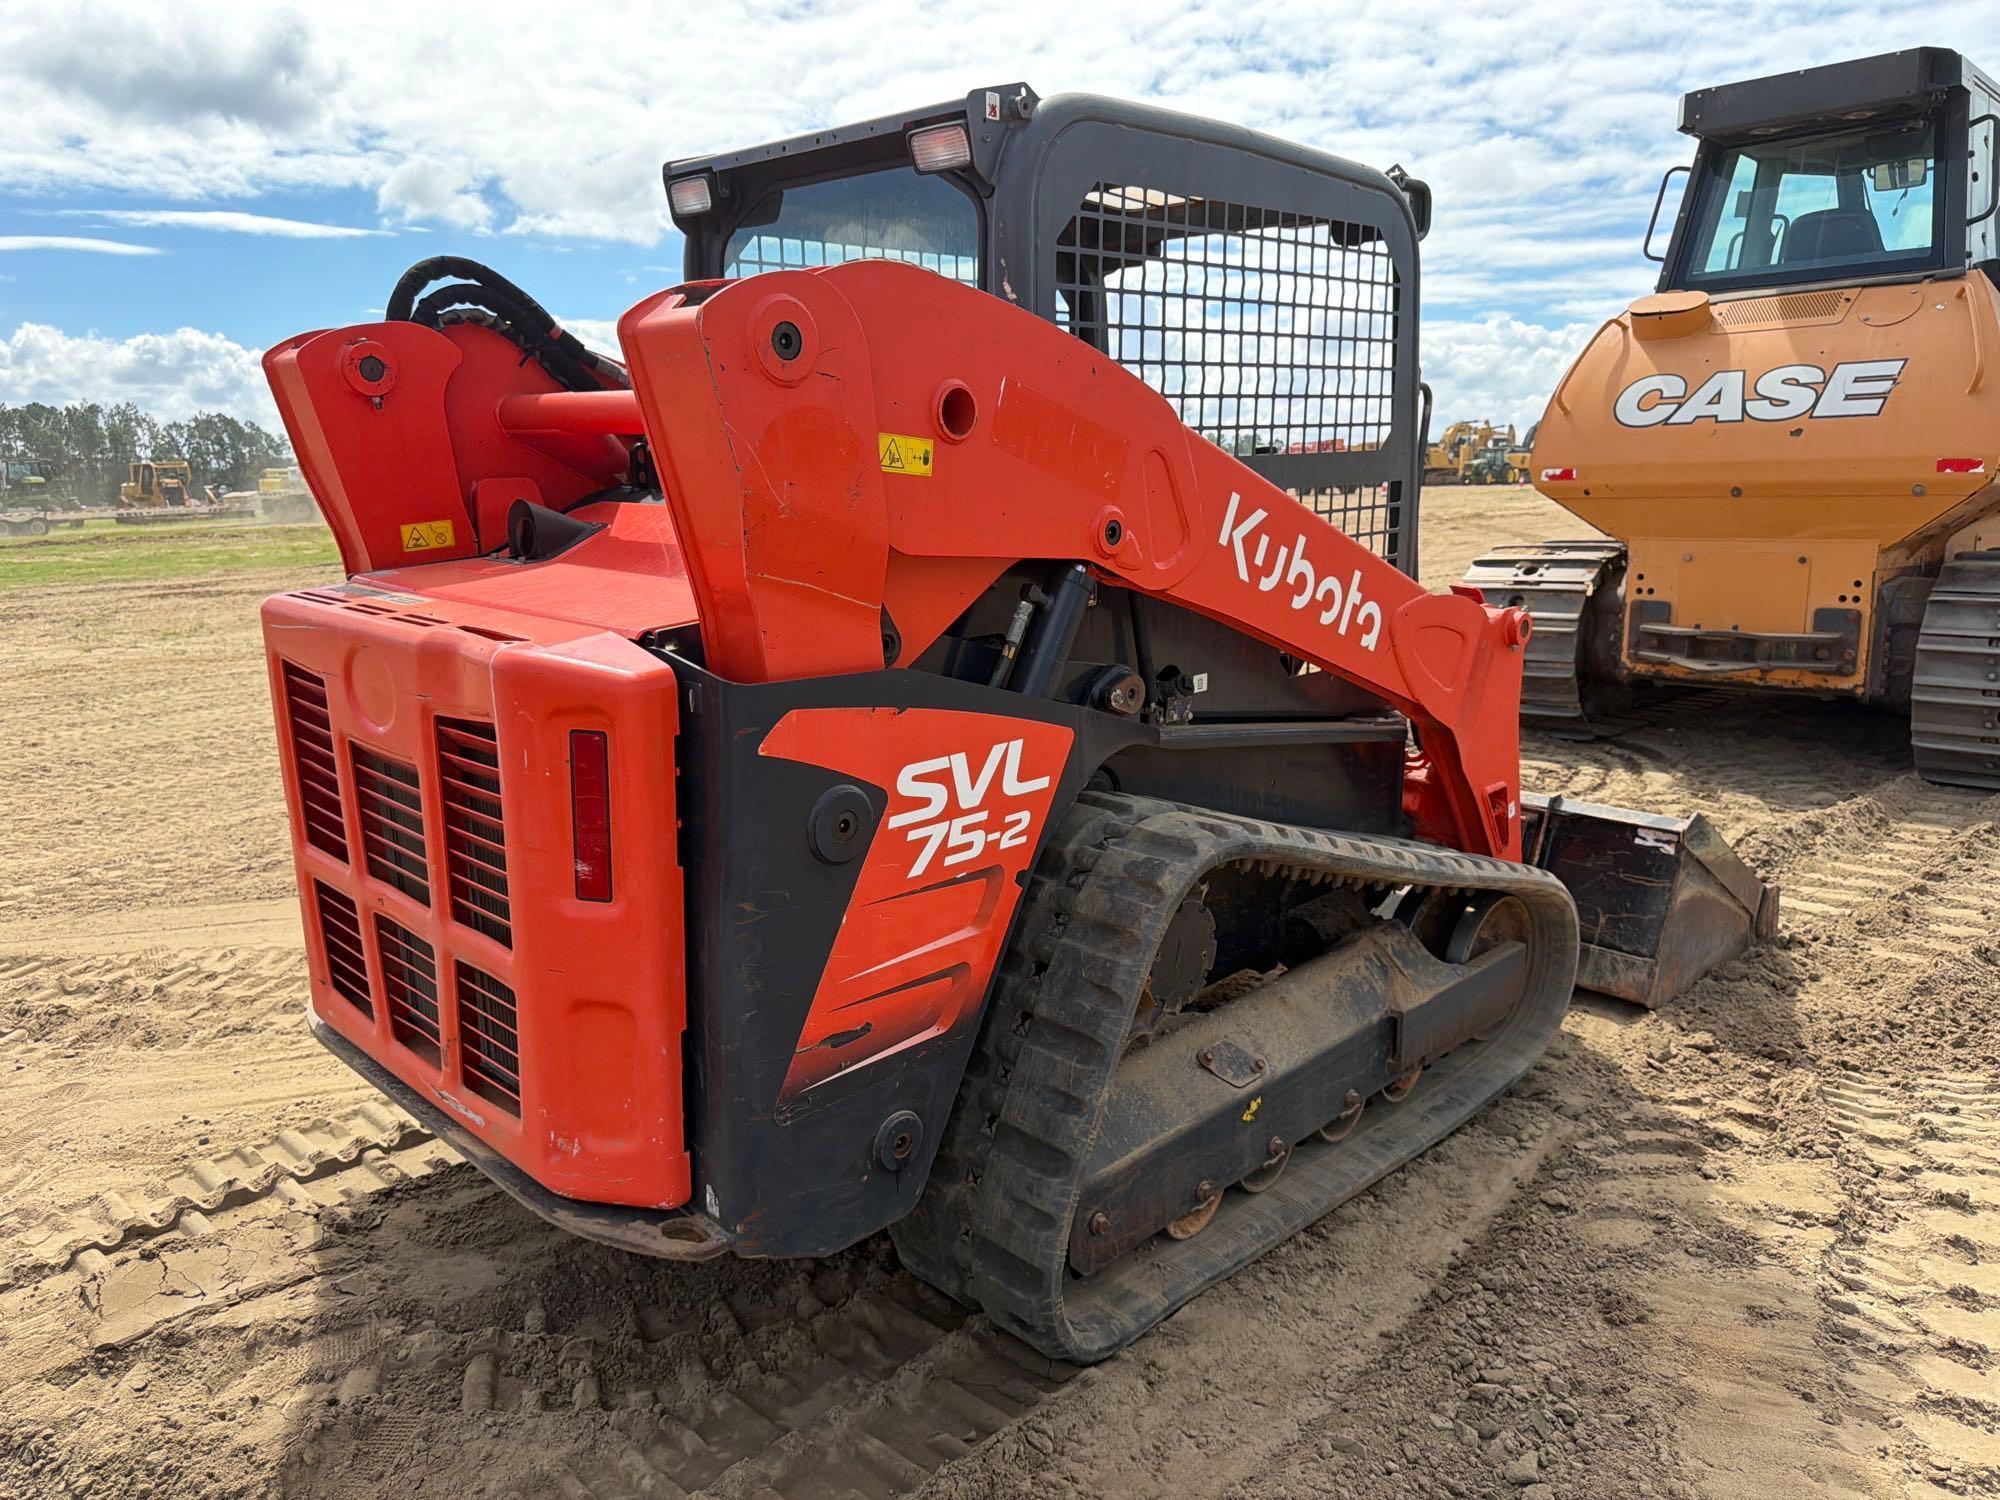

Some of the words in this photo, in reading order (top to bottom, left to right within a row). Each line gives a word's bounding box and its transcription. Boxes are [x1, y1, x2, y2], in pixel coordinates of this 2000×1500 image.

[1613, 358, 1909, 428] CASE
[1218, 491, 1382, 653] Kubota
[888, 739, 1050, 829] SVL
[906, 810, 1031, 879] 75-2
